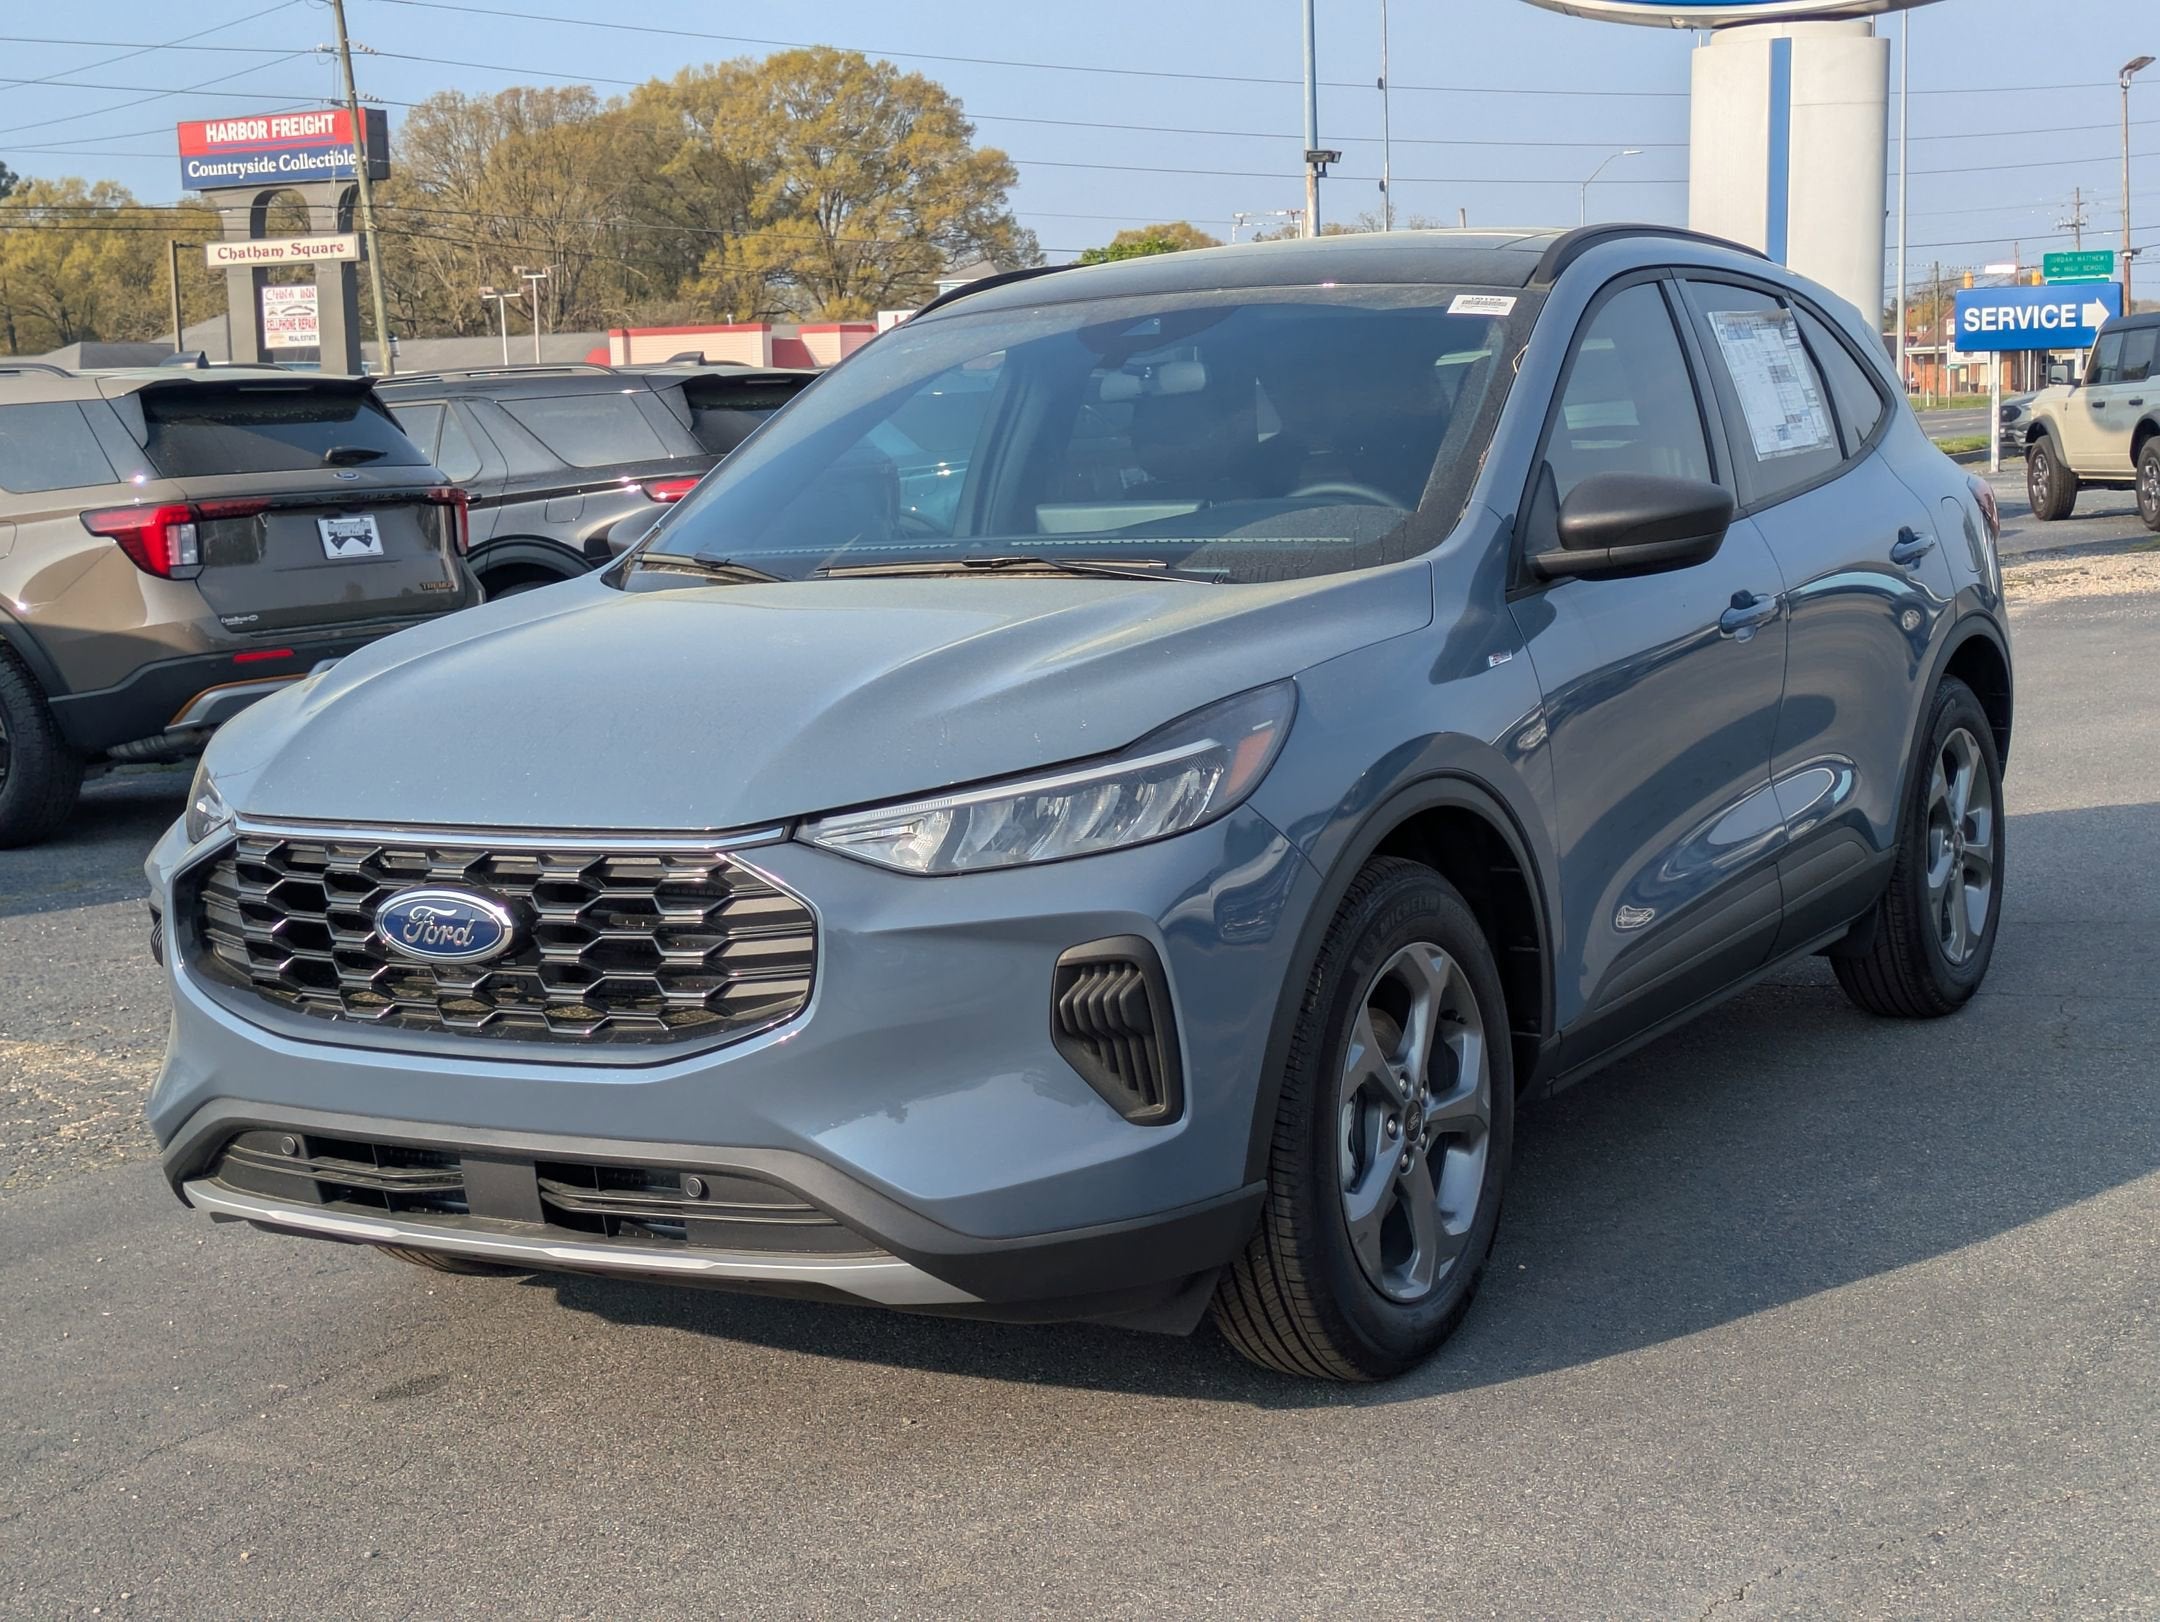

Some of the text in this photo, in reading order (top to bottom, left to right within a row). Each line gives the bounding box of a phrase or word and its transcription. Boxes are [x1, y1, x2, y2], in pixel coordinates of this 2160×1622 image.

[206, 114, 335, 142] HARBOR FREIGHT
[188, 158, 276, 179] Countryside
[217, 242, 345, 260] Chatham Square
[1963, 304, 2077, 332] SERVICE
[403, 905, 475, 947] Ford
